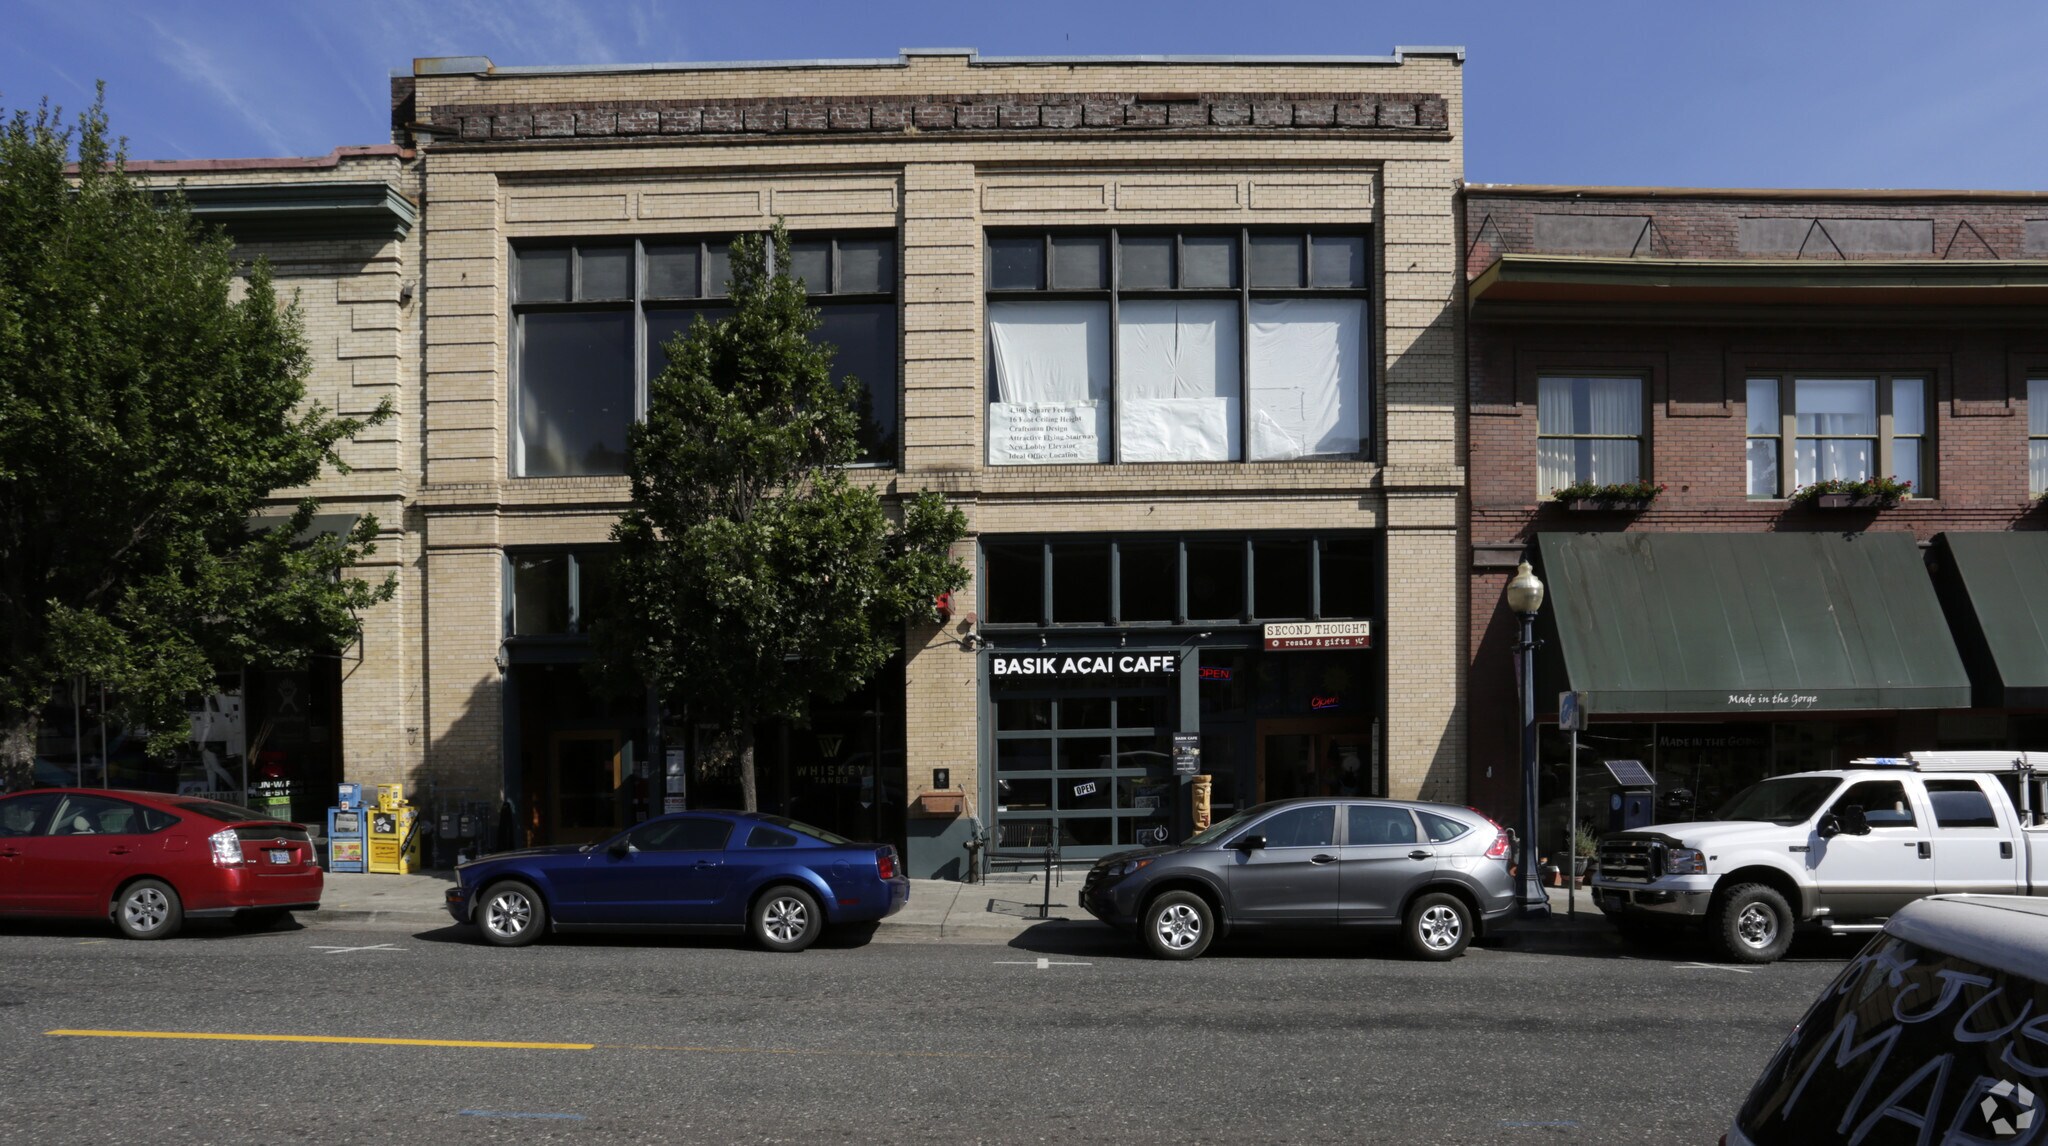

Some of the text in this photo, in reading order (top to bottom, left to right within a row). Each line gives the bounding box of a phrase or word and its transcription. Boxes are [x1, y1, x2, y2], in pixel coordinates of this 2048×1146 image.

[1008, 434, 1041, 442] Attractive
[1025, 443, 1046, 451] Lobby
[1267, 623, 1367, 636] SECOND THOUGHT
[1285, 637, 1350, 647] resale & gifts
[993, 655, 1175, 675] BASIK AÇAI CAFE
[1199, 667, 1230, 679] OPEN
[1727, 692, 1818, 709] Made in the Gorge
[1659, 736, 1690, 748] MADE
[1691, 736, 1704, 747] IN
[1704, 737, 1726, 747] THE
[796, 765, 865, 777] WHISKEY
[814, 776, 848, 785] TANGO
[1076, 783, 1095, 795] OPEN
